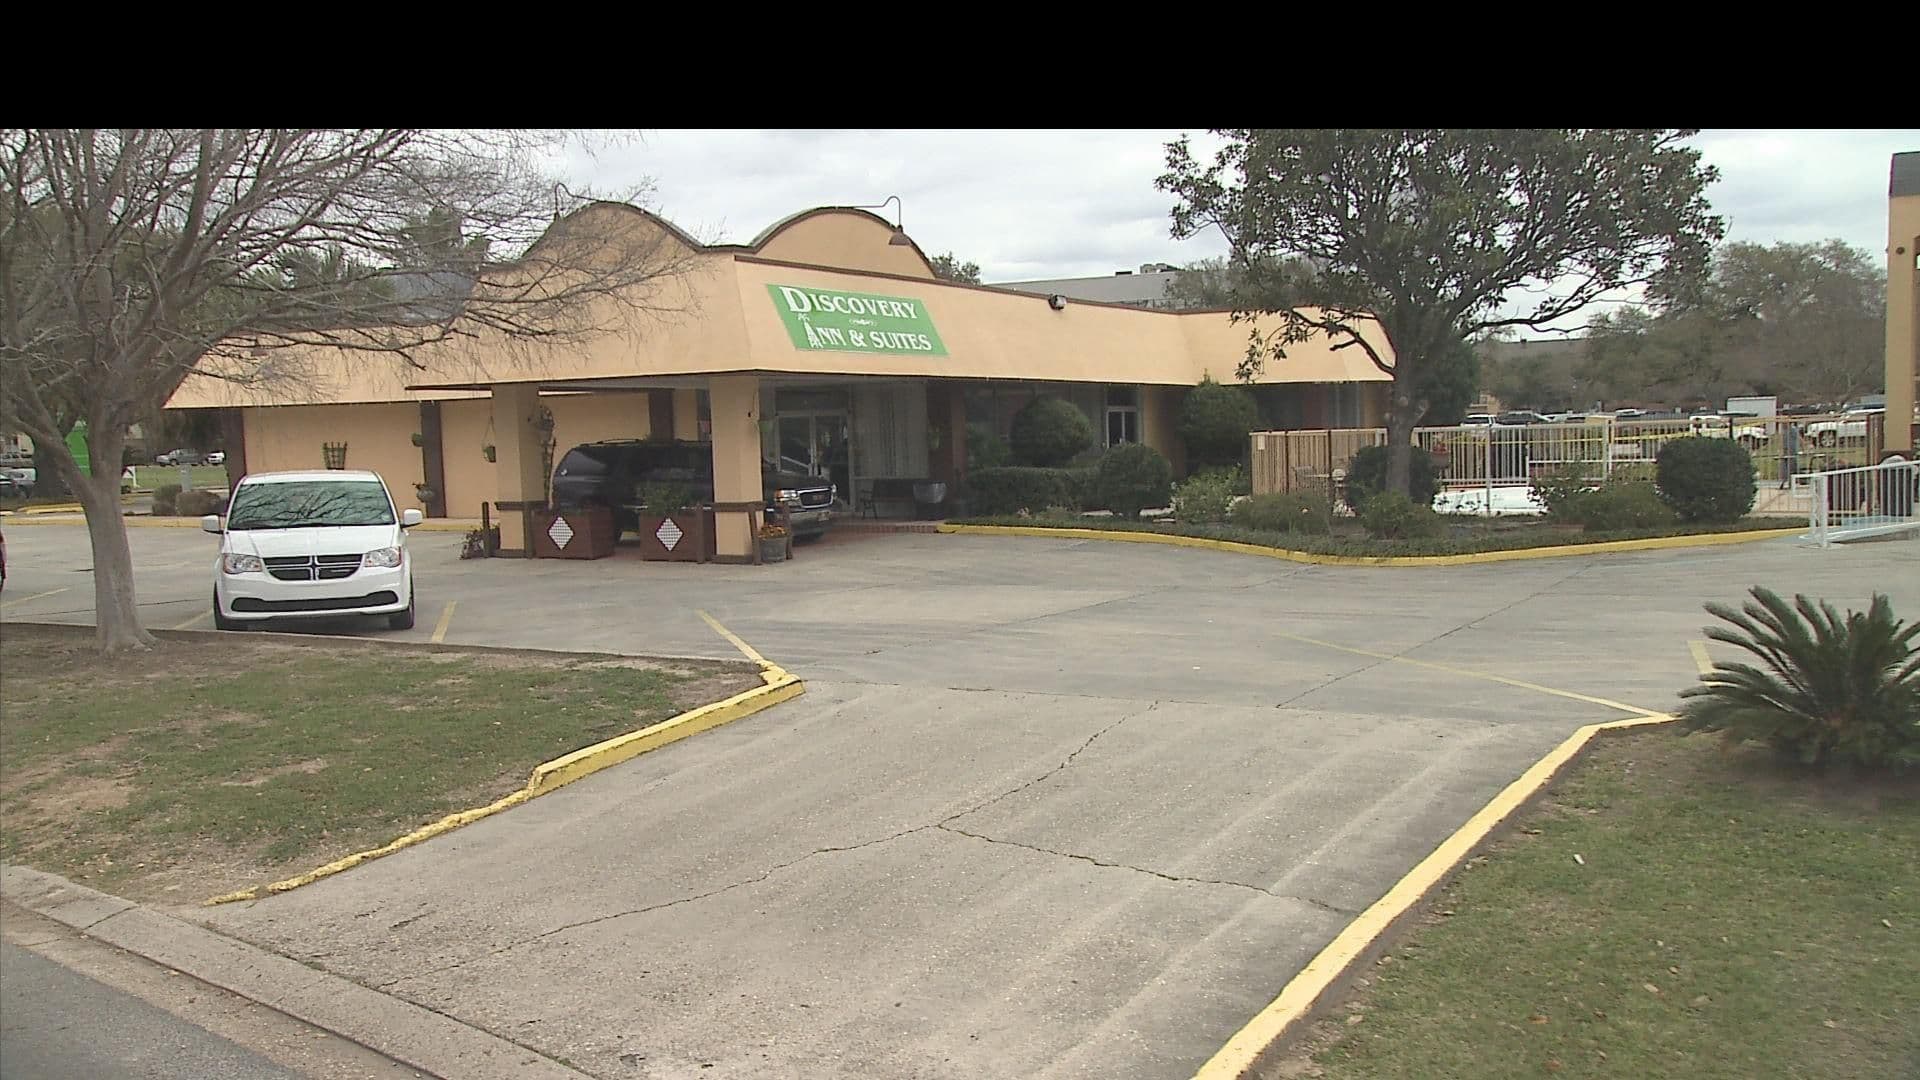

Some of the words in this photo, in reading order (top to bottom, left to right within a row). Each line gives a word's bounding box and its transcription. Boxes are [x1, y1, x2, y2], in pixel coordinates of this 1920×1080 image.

[779, 287, 918, 319] DISCOVERY
[849, 329, 867, 347] &
[869, 331, 932, 351] SUITES
